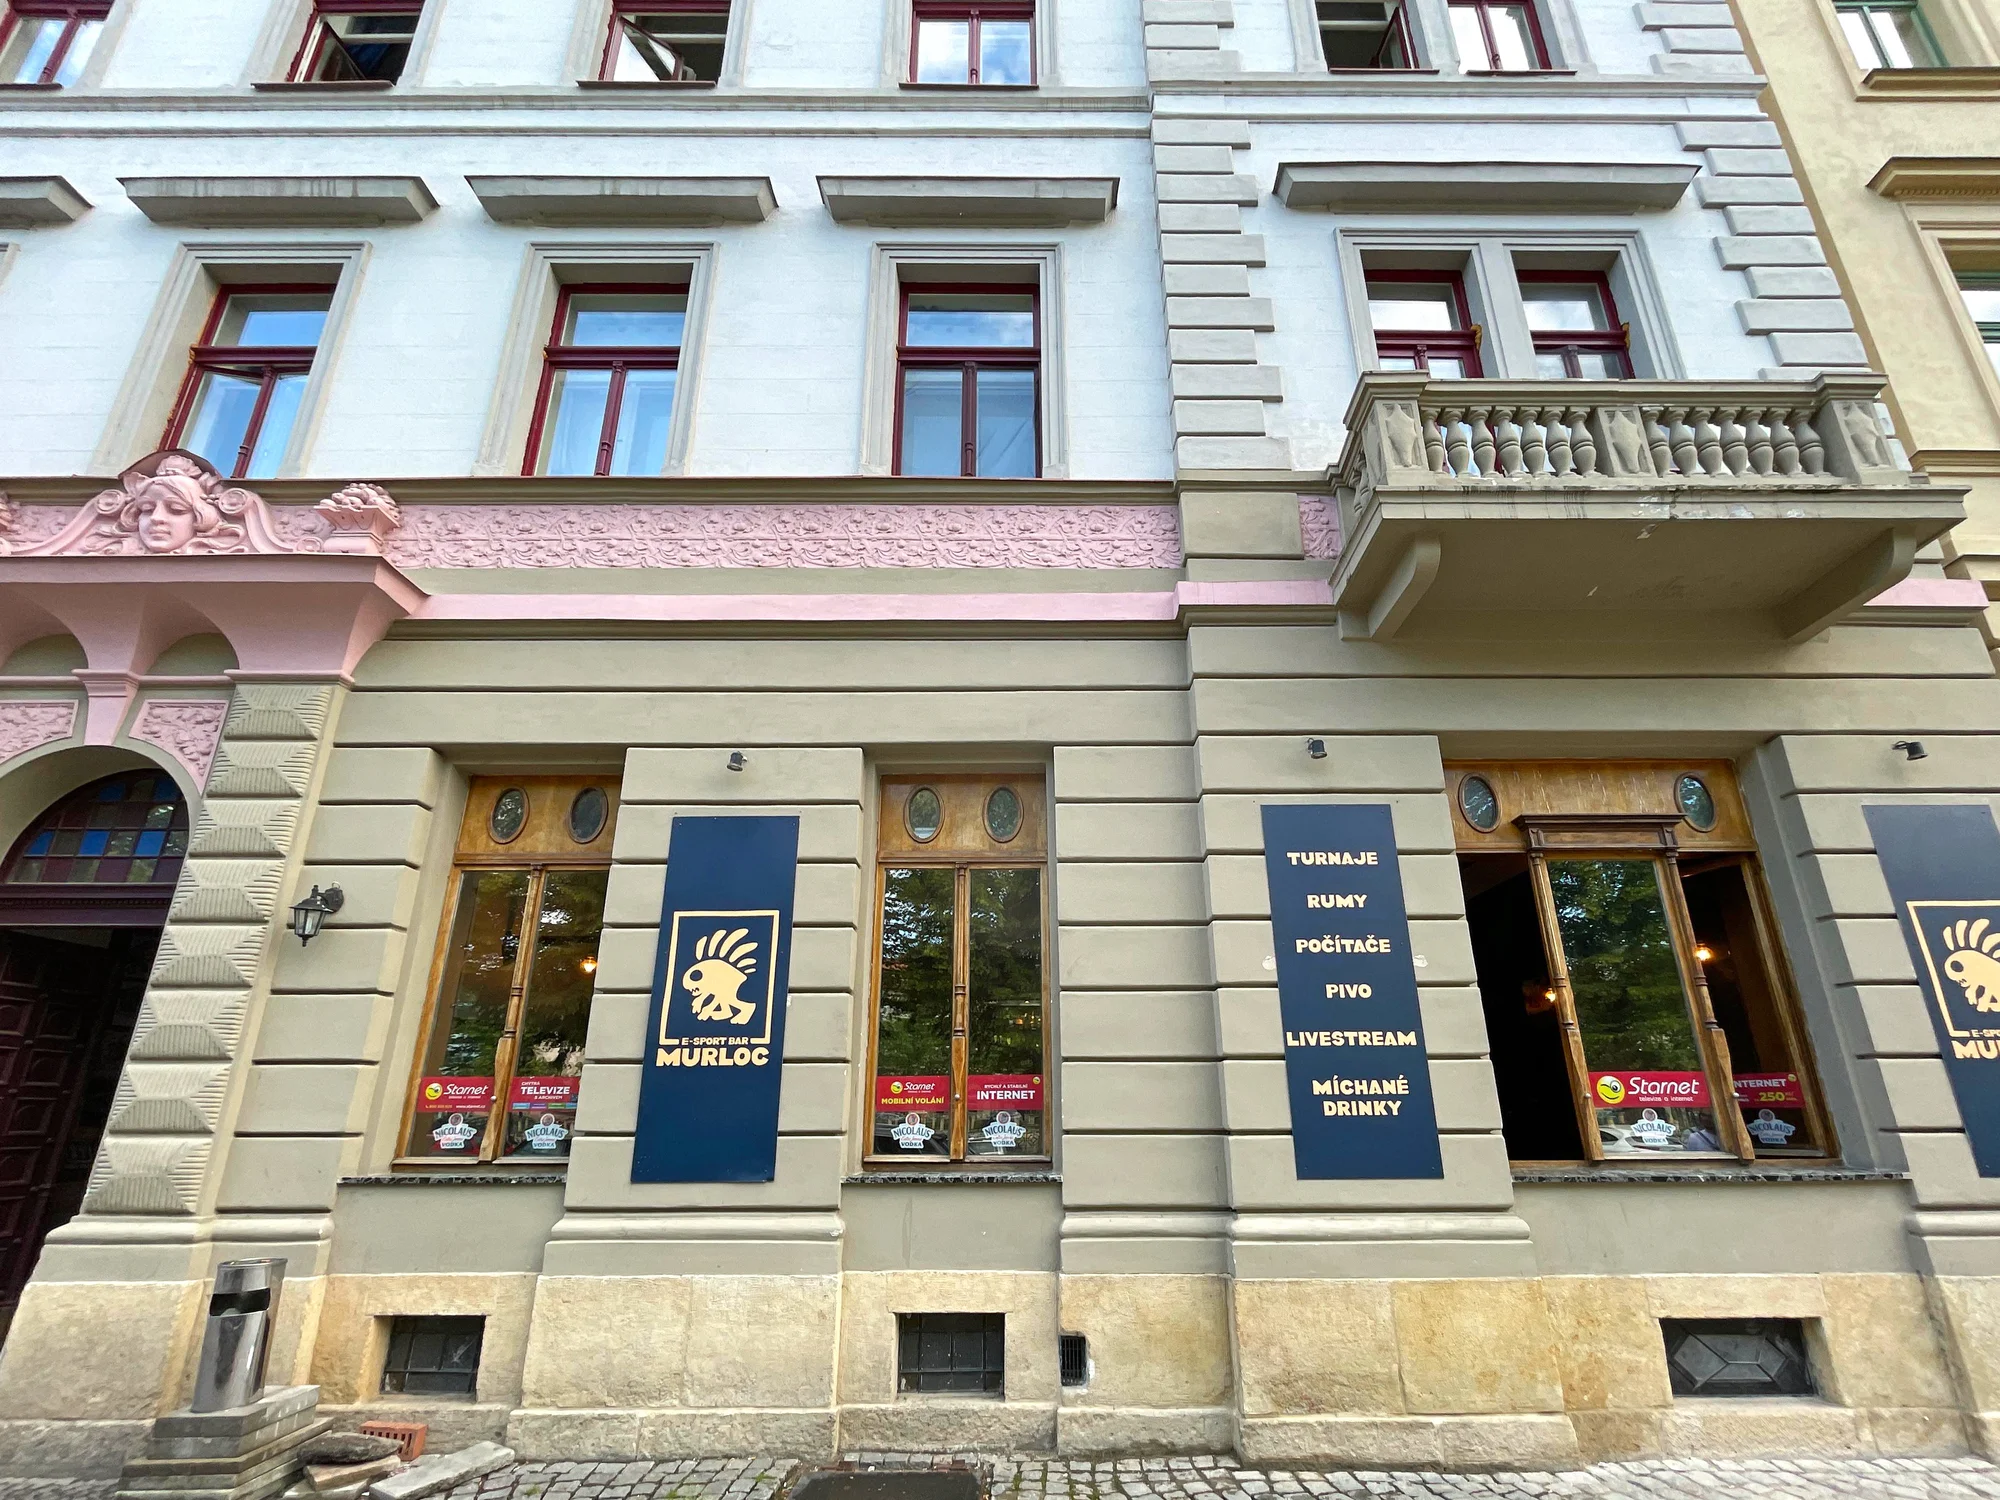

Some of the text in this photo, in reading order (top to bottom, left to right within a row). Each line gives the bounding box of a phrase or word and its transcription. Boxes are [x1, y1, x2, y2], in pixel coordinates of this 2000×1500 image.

[1286, 851, 1379, 866] TURNAJE
[1306, 894, 1368, 909] RUMY
[1295, 934, 1392, 954] POČÍTAČE
[1325, 983, 1373, 999] PIVO
[681, 1036, 749, 1046] E-SPORT BAR
[1286, 1031, 1418, 1047] LIVESTREAM
[656, 1047, 770, 1068] MURLOC
[443, 1083, 489, 1095] Starnet
[903, 1081, 936, 1091] Starnet
[1312, 1074, 1410, 1096] MÍCHANÉ
[1627, 1076, 1700, 1095] Starnet
[1732, 1078, 1787, 1088] NTERNET
[520, 1086, 571, 1095] TELEVIZE
[976, 1090, 1036, 1100] INTERNET
[1759, 1091, 1786, 1102] 250
[881, 1096, 945, 1105] MOBILNÍ VOLÁNÍ
[1322, 1100, 1402, 1117] DRINKY
[434, 1127, 474, 1138] NICOLAUS
[526, 1127, 566, 1139] NICOLAUS
[893, 1126, 931, 1138] NICOLAUS
[984, 1125, 1023, 1137] NICOLAUS
[1633, 1122, 1673, 1134] NICOLAUS
